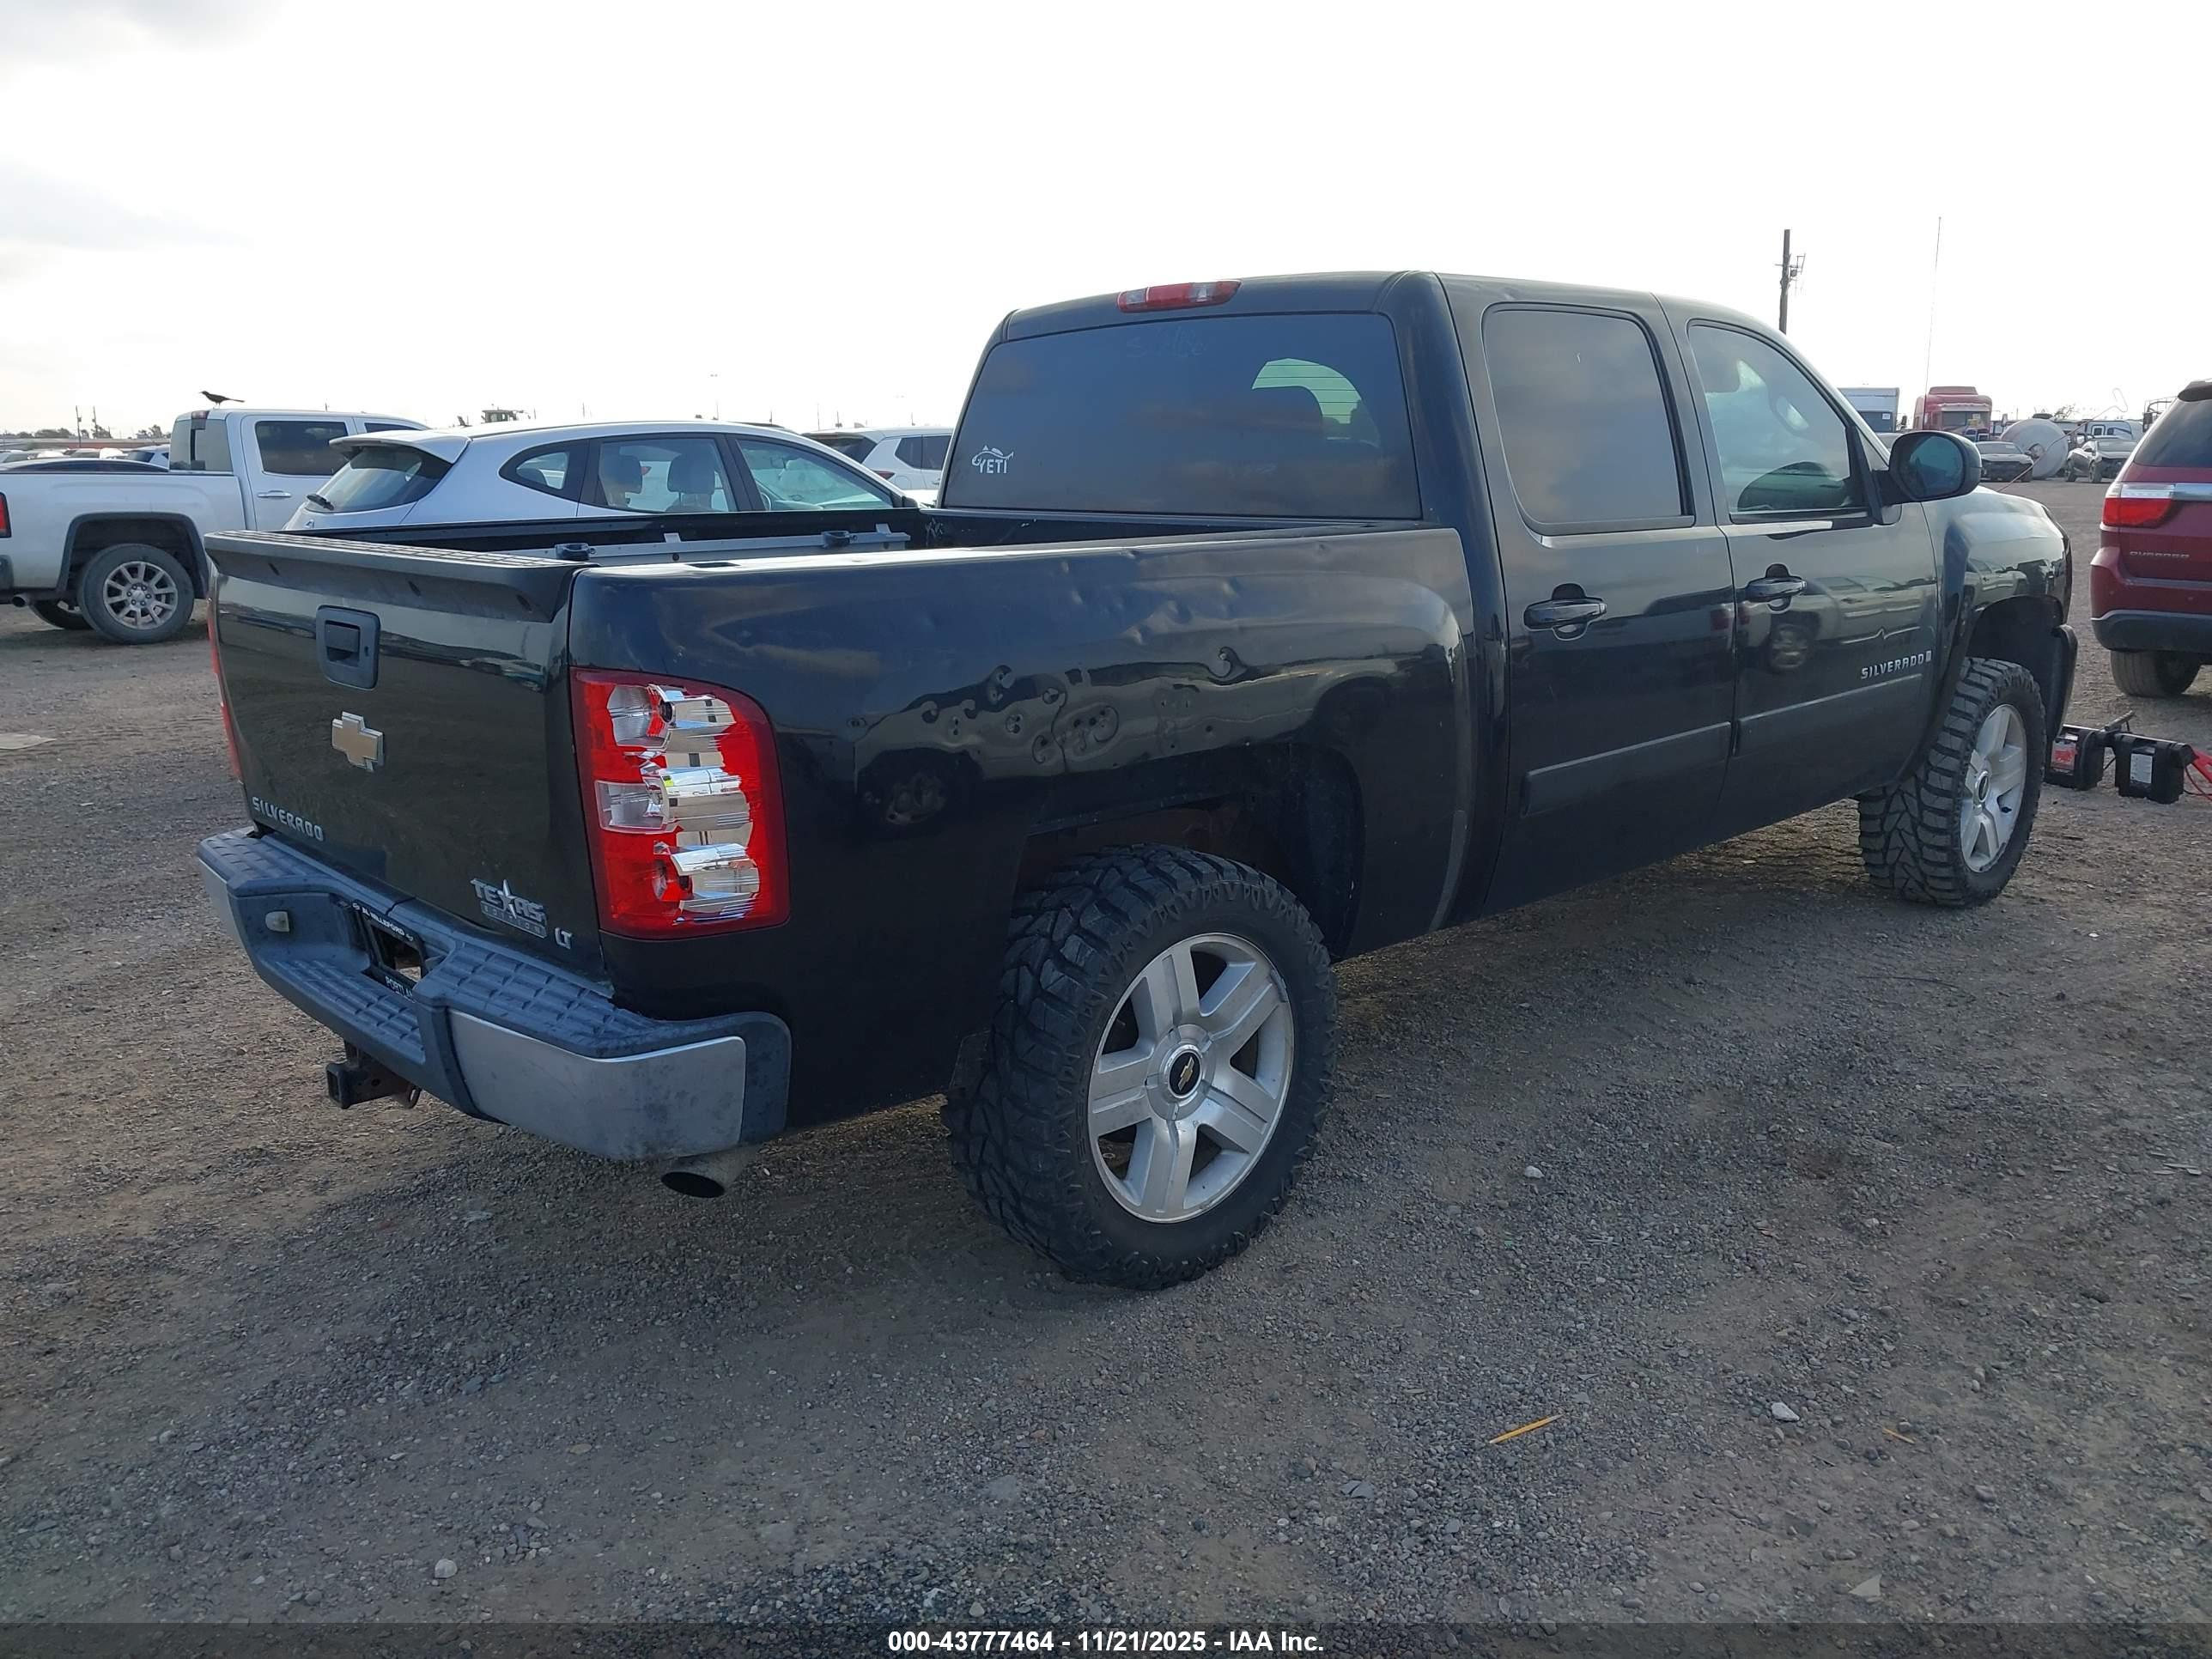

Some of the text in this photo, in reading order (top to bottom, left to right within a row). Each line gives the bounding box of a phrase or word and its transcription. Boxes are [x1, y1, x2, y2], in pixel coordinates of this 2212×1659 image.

[979, 458, 1007, 473] YETI
[1860, 653, 1924, 679] SILVERADO
[252, 796, 324, 842] SILVERADO
[470, 878, 547, 940] TEXAS
[554, 927, 573, 950] LT
